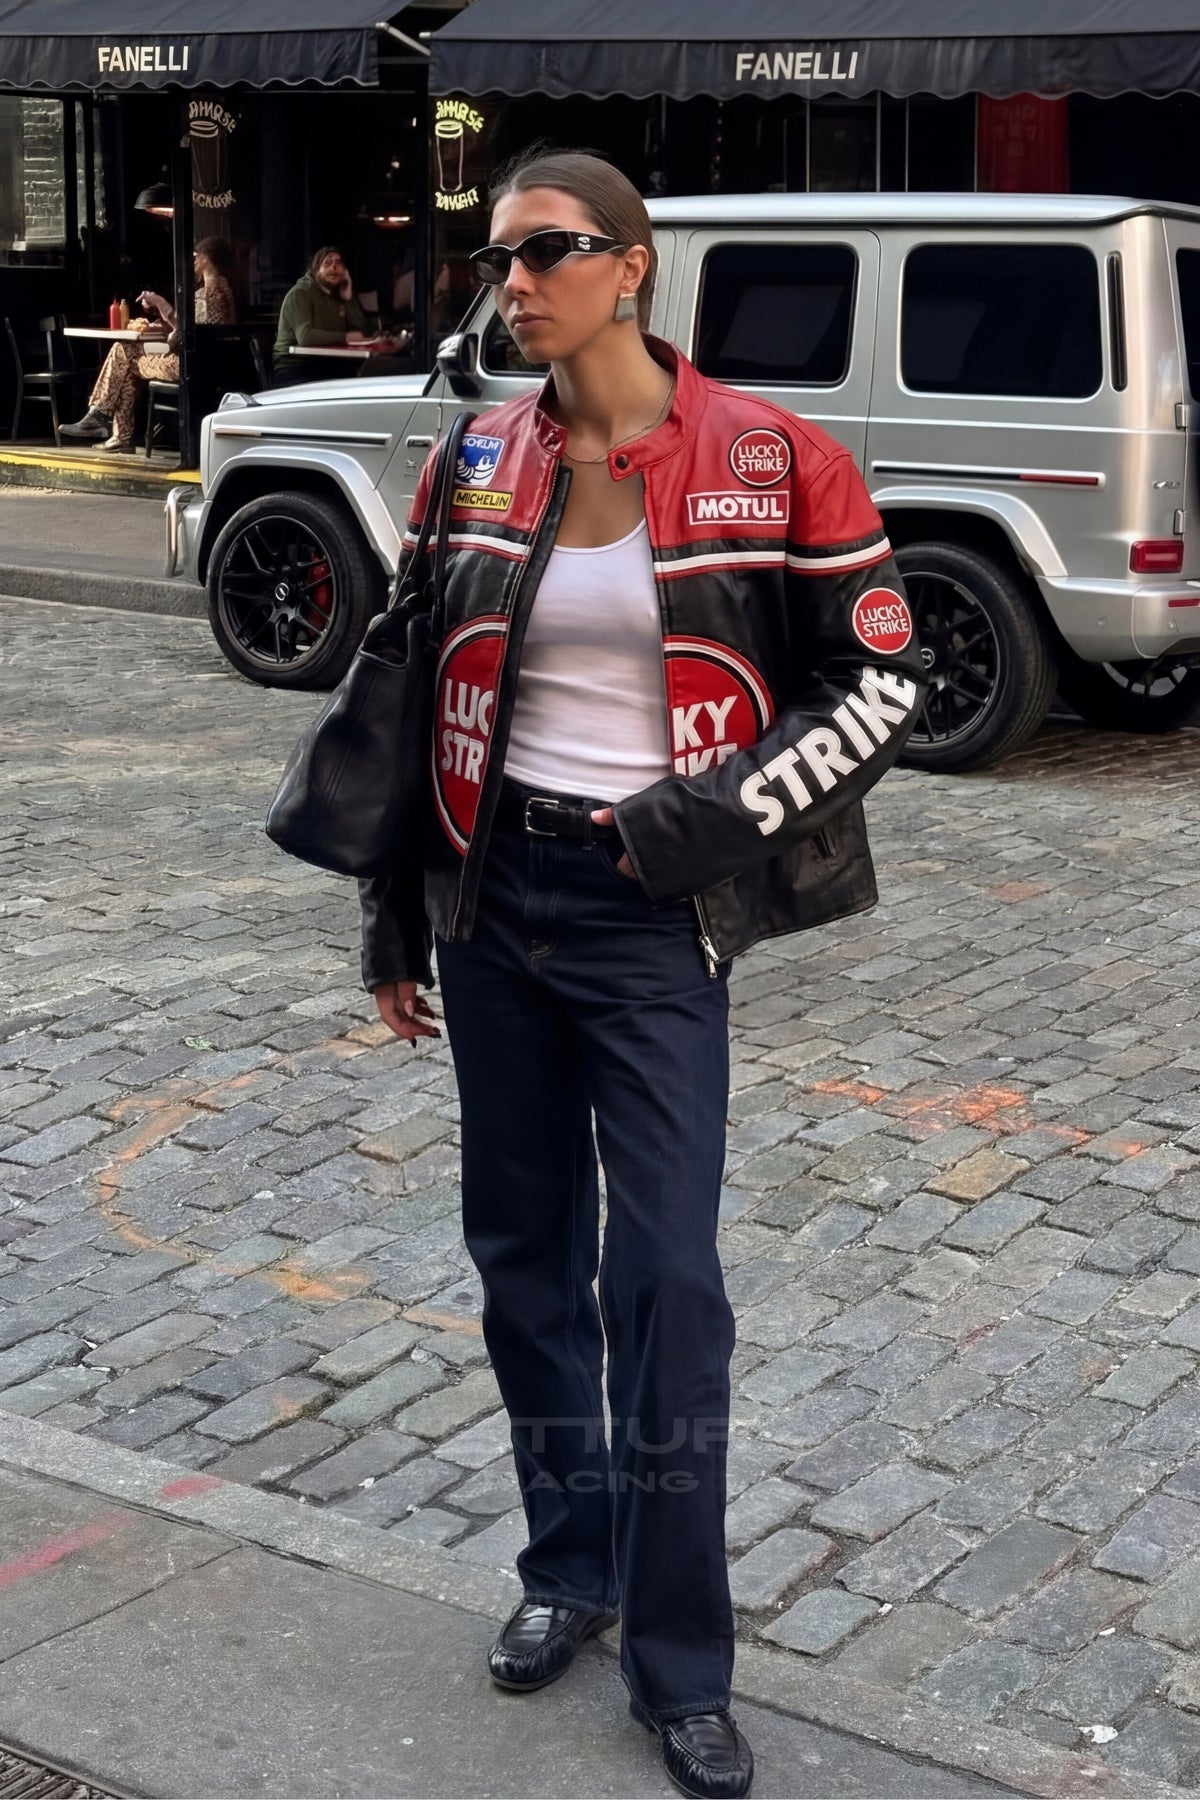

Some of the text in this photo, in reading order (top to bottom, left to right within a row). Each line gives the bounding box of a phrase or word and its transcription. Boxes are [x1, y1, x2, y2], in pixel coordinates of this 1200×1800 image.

[98, 45, 189, 72] FANELLI
[735, 51, 858, 81] FANELLI
[738, 444, 782, 458] LUCKY
[738, 457, 784, 472] STRIKE
[696, 496, 784, 519] MOTUL
[859, 604, 904, 624] LUCKY
[863, 617, 910, 638] STRIKE
[740, 665, 917, 836] STRIKE
